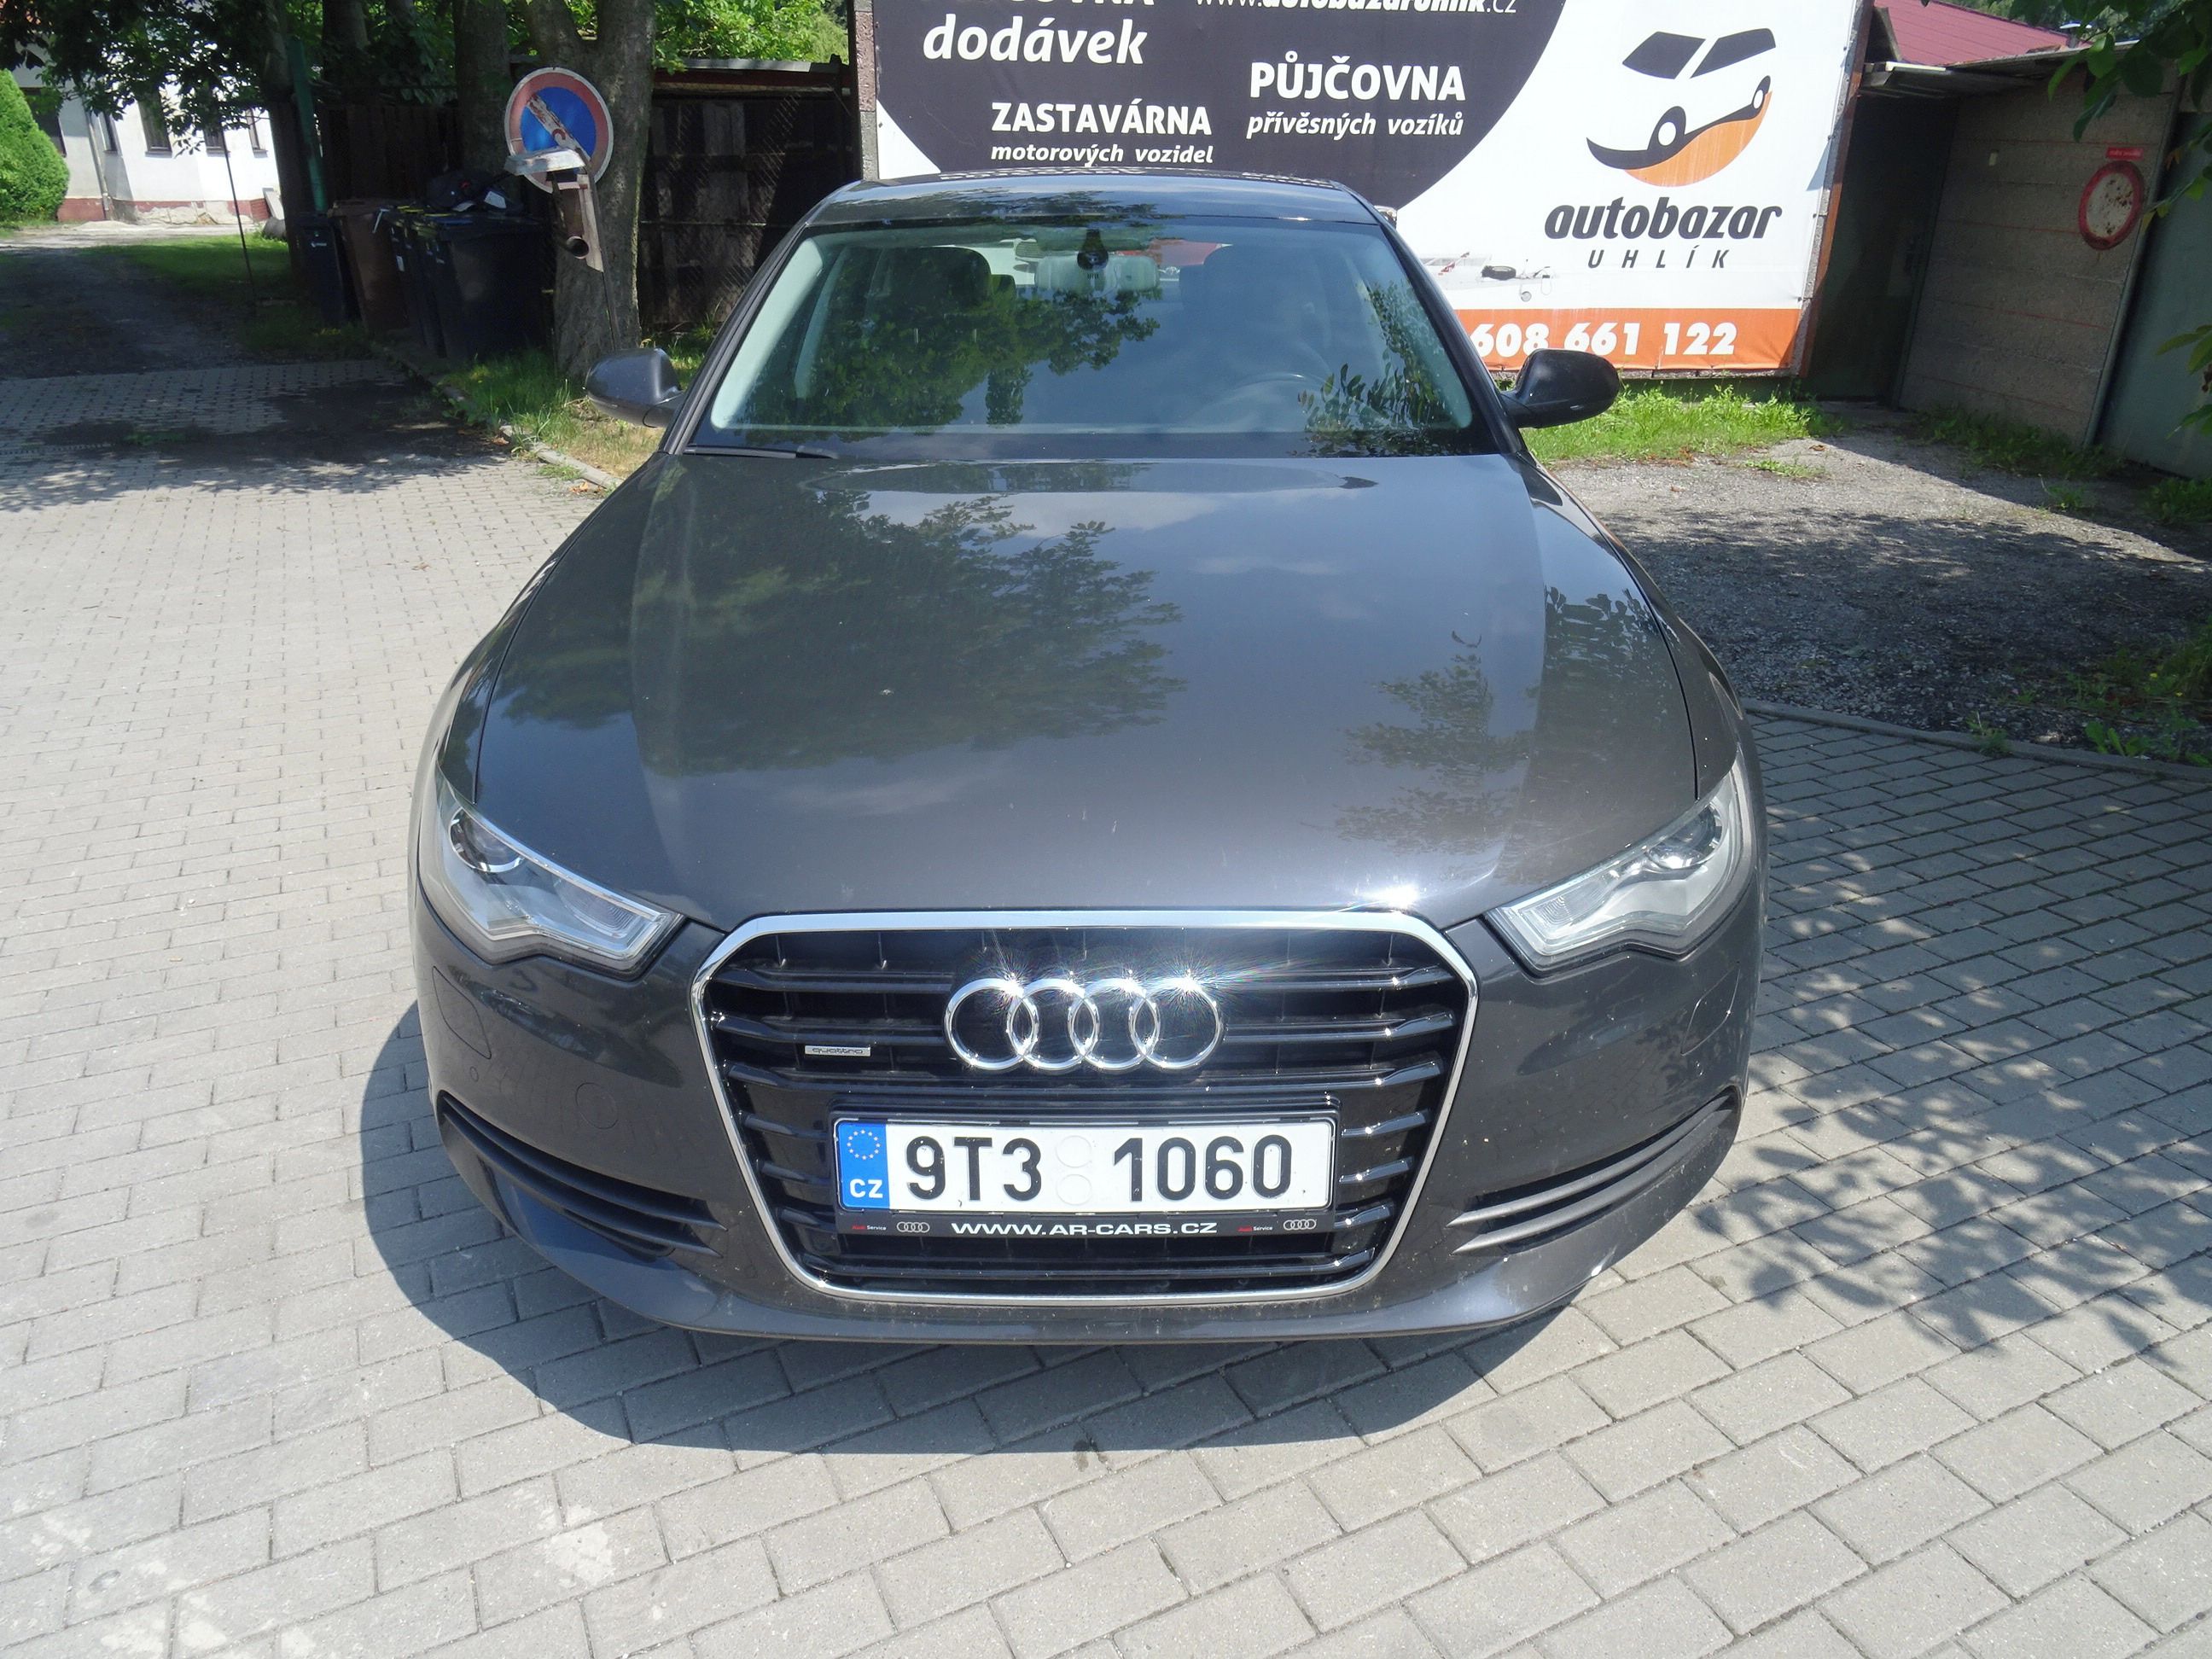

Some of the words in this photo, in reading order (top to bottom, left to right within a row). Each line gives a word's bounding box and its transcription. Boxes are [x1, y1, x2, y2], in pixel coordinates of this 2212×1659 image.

[923, 13, 1148, 64] dodávek
[1249, 50, 1466, 101] PŮJČOVNA
[991, 98, 1212, 135] ZASTAVÁRNA
[1246, 111, 1377, 141] přívěsných
[1388, 111, 1464, 136] vozíků
[991, 143, 1123, 167] motorových
[1135, 145, 1214, 164] vozidel
[1545, 196, 1783, 240] autobazar
[1587, 245, 1730, 269] UHLÍK
[1470, 323, 1550, 358] 608
[1563, 323, 1640, 355] 661
[1663, 323, 1738, 355] 122
[905, 1135, 1043, 1202] 9T3
[1113, 1134, 1292, 1202] 1060
[850, 1179, 883, 1199] CZ
[952, 1222, 1217, 1236] WWW.AR-CARS.CZ
